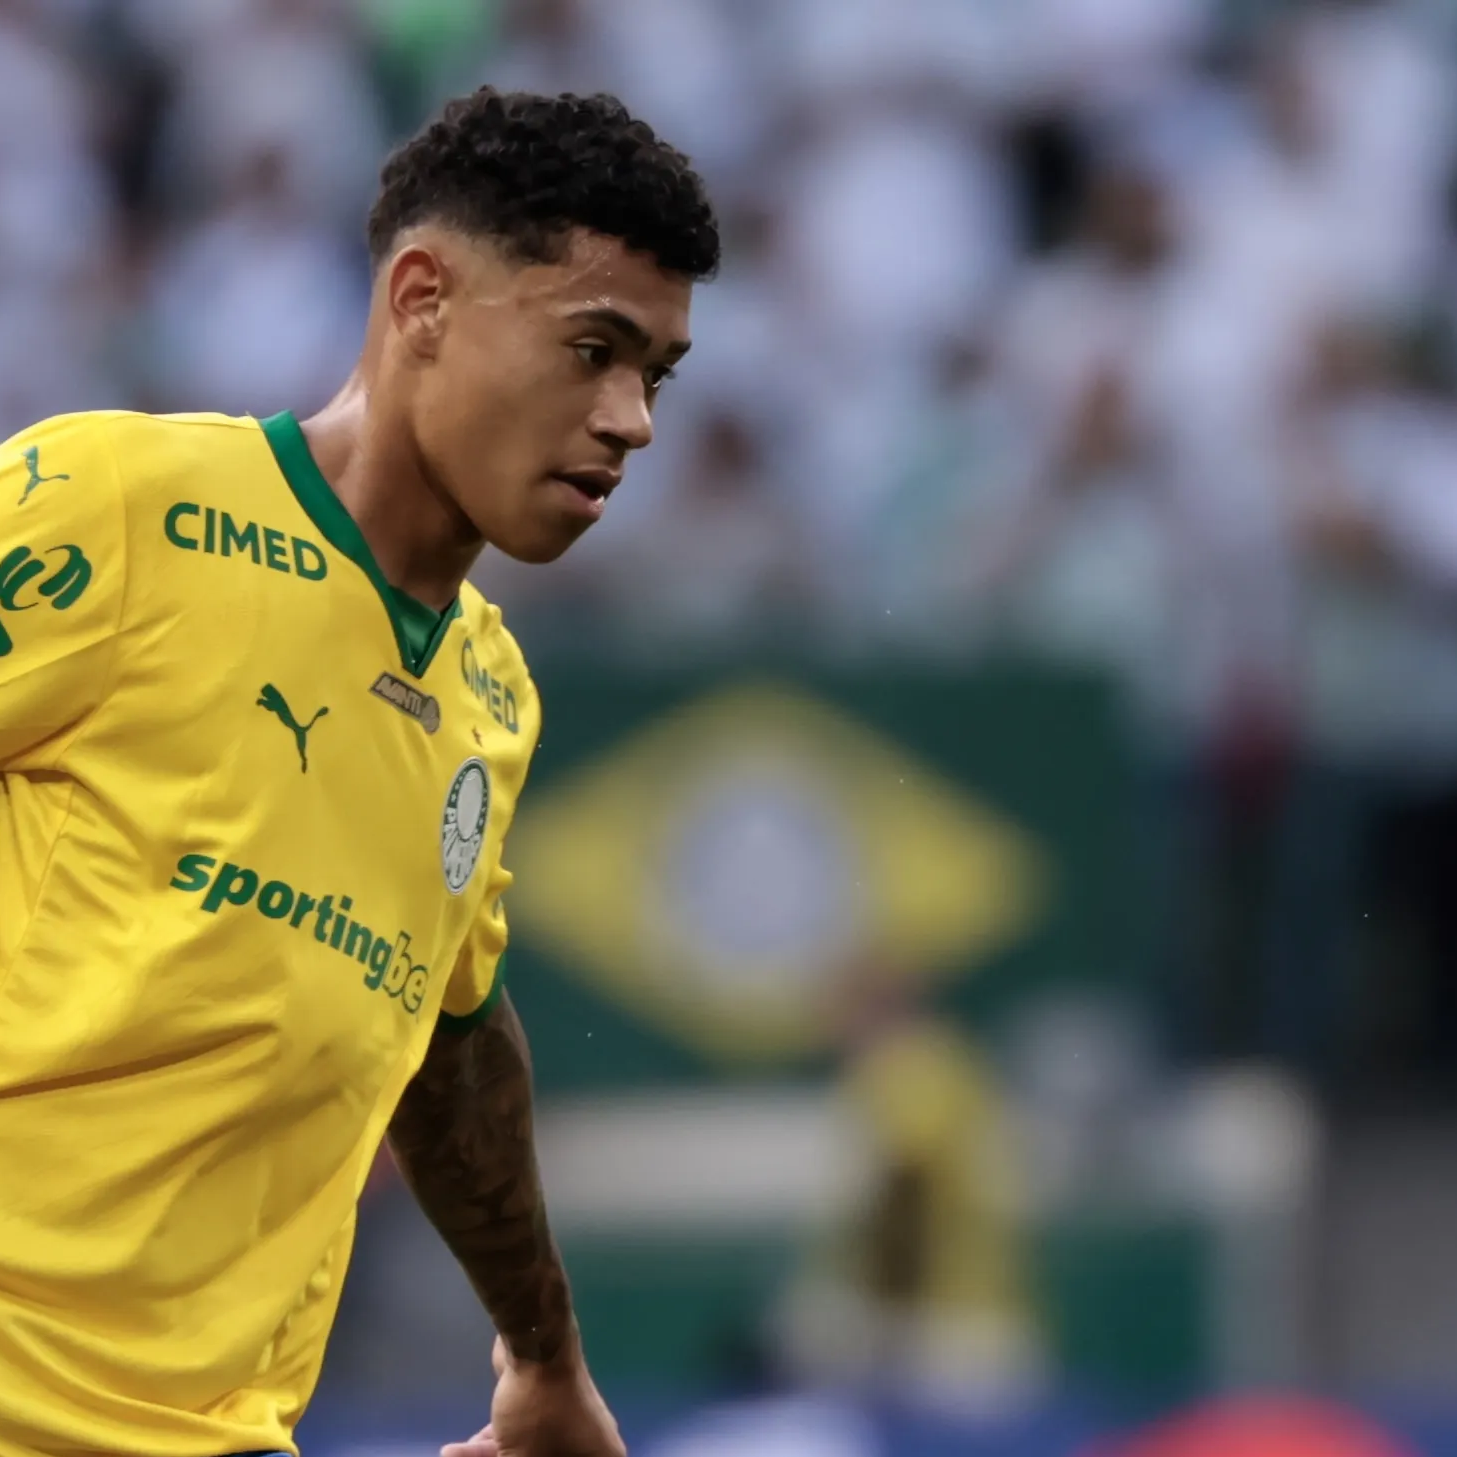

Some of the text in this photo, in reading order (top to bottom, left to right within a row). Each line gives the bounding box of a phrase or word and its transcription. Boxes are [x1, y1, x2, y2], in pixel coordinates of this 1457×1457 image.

[164, 502, 329, 582] CIMED
[461, 637, 519, 736] CIMED
[169, 853, 429, 1014] sportingbe
